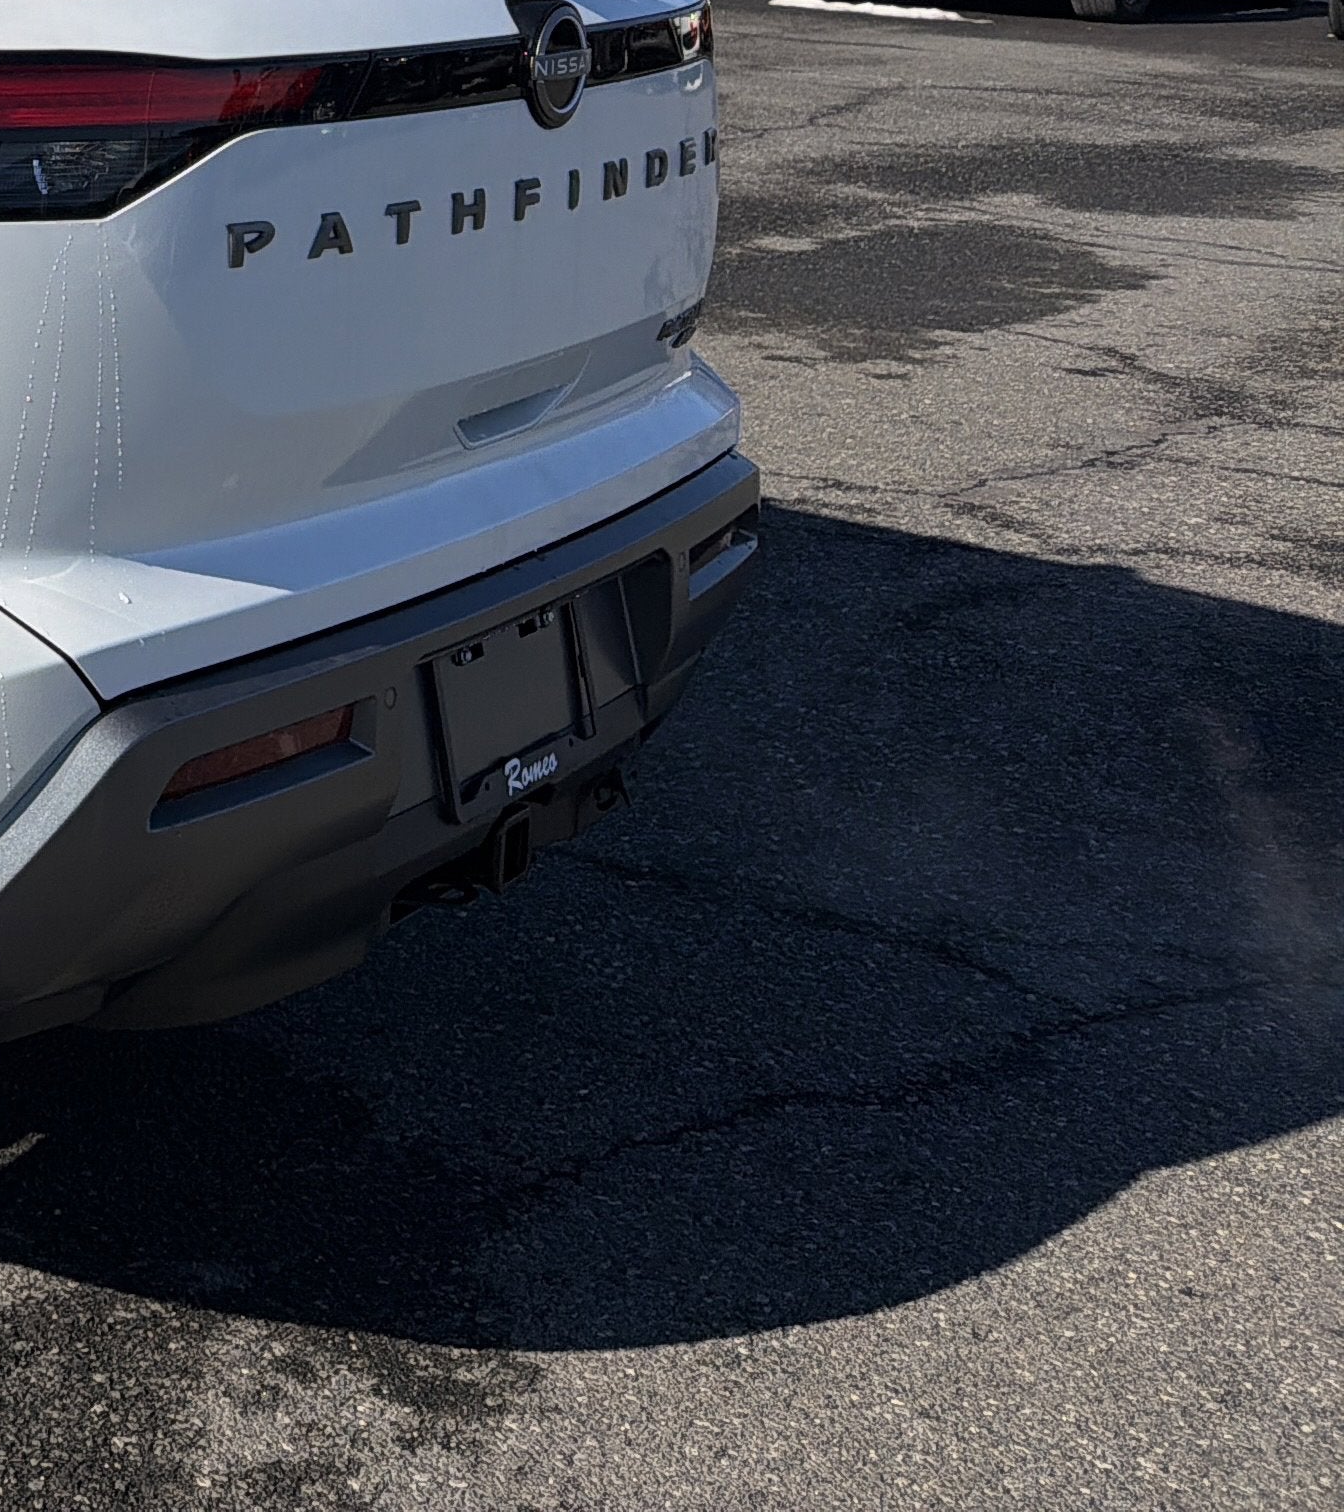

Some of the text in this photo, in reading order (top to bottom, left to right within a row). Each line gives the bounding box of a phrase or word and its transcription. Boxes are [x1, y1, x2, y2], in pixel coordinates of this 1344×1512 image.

[534, 55, 589, 77] NISSA
[226, 126, 718, 269] PATHFINDER
[504, 752, 558, 797] Romeo
